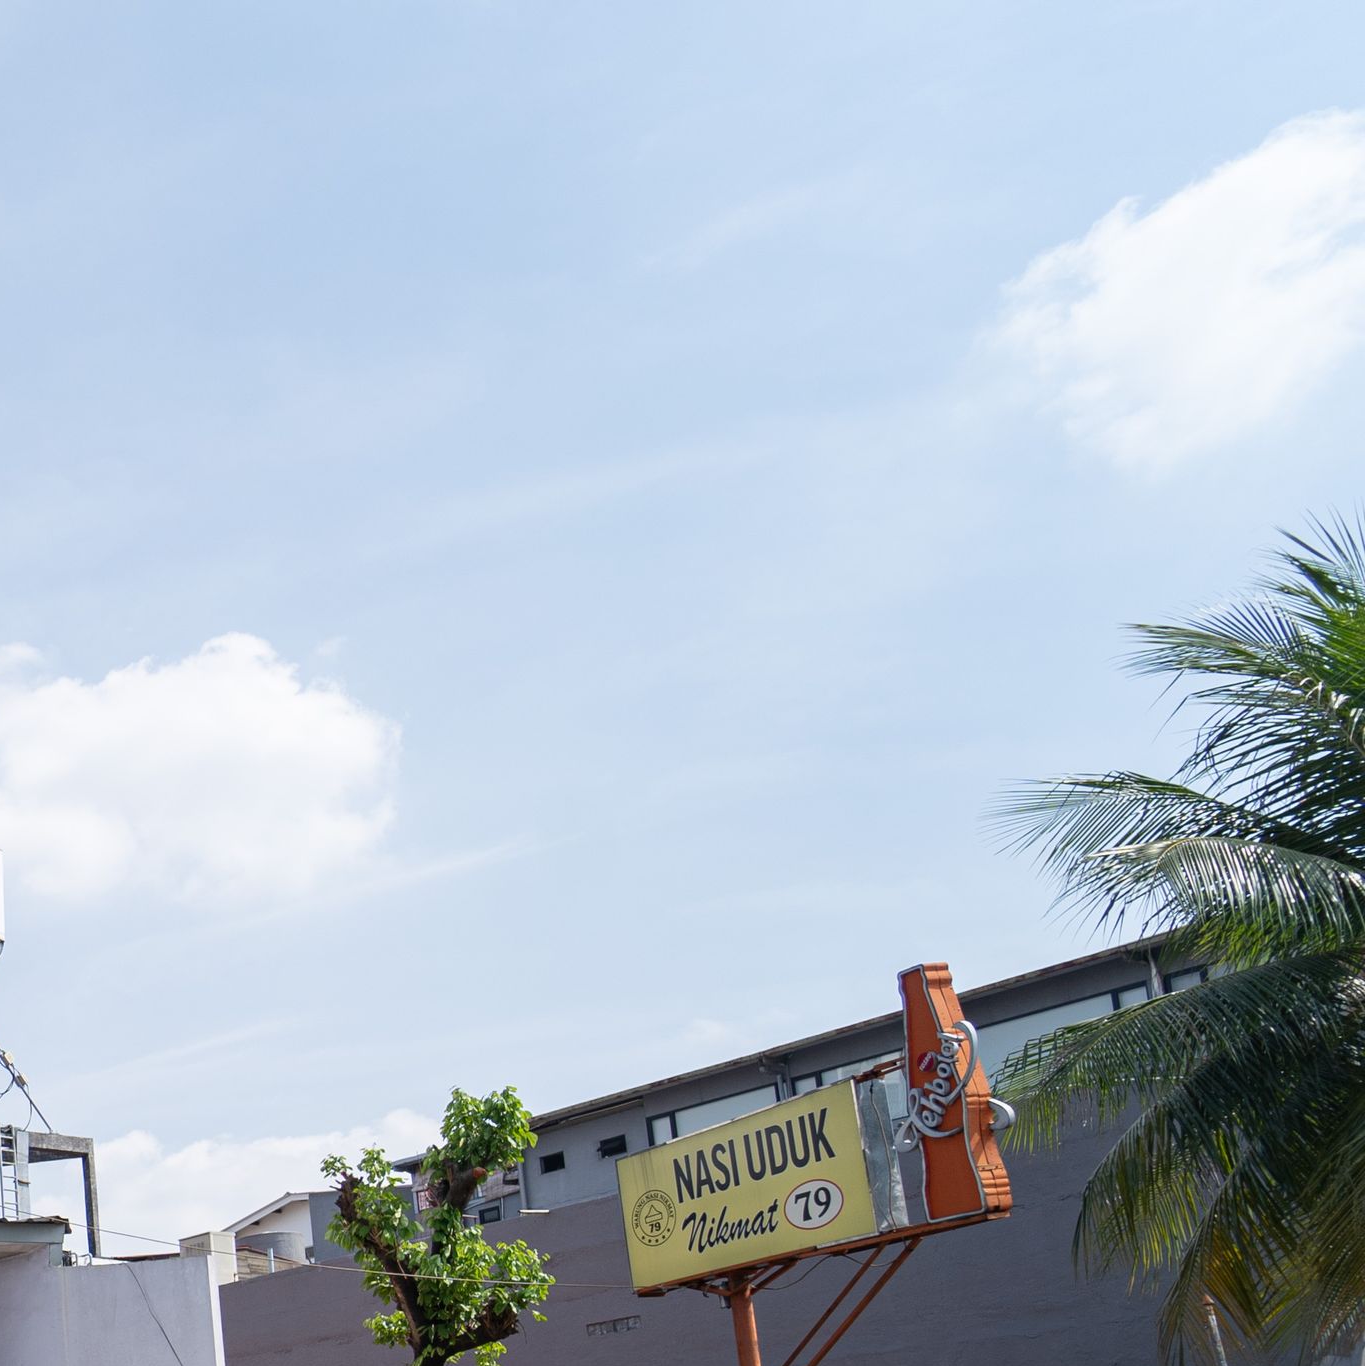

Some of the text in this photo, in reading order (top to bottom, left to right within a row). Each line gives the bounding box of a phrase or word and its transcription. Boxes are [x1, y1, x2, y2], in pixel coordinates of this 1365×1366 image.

[673, 1107, 836, 1204] NASI UDUK
[649, 1222, 661, 1233] 79
[681, 1185, 832, 1254] Nikmat 79
